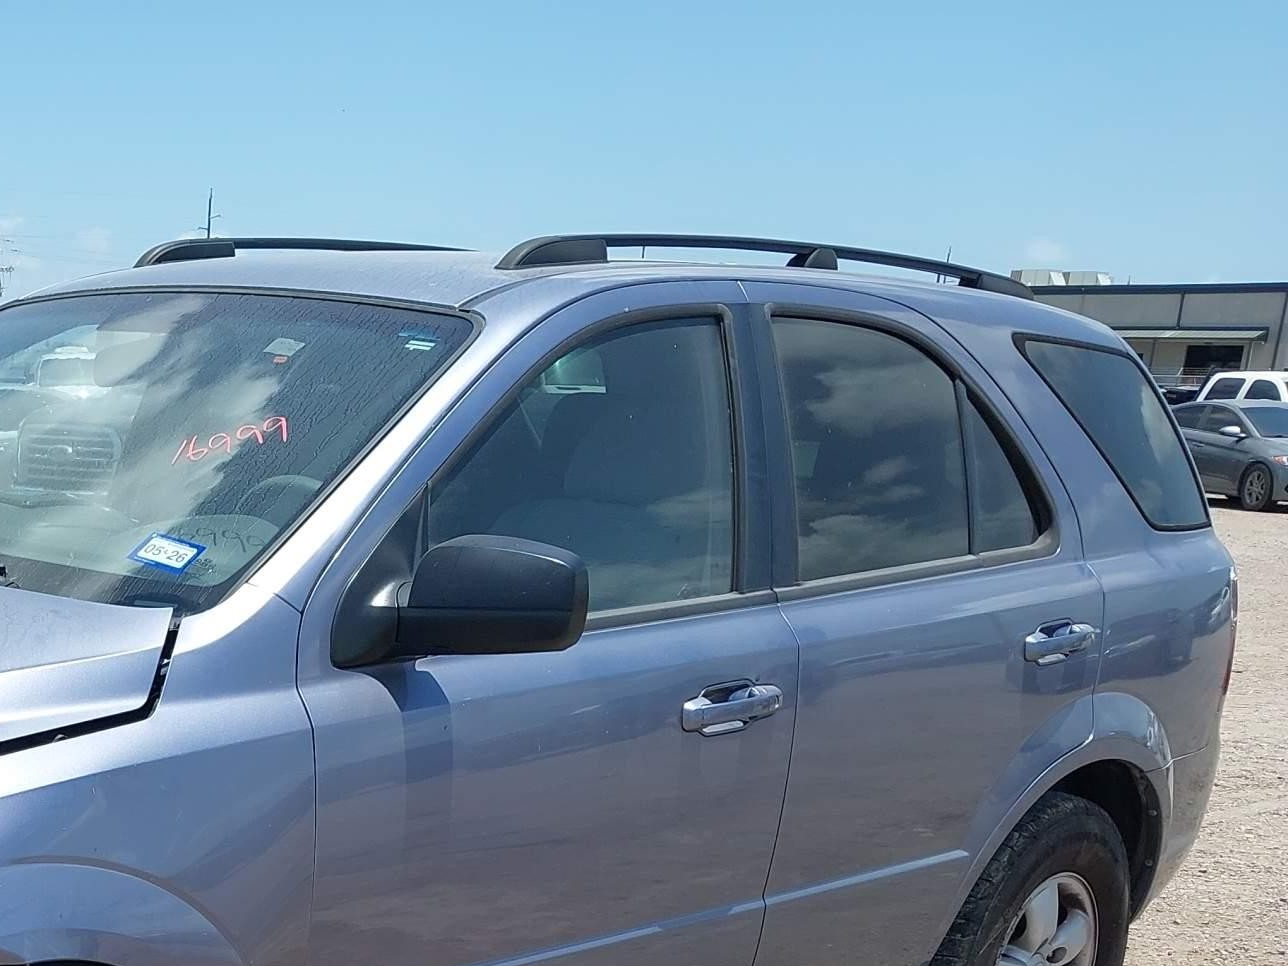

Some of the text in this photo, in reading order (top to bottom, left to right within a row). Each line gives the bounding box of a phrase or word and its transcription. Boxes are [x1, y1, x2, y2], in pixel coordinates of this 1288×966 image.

[171, 416, 289, 465] 16999
[144, 543, 190, 564] 05 26
